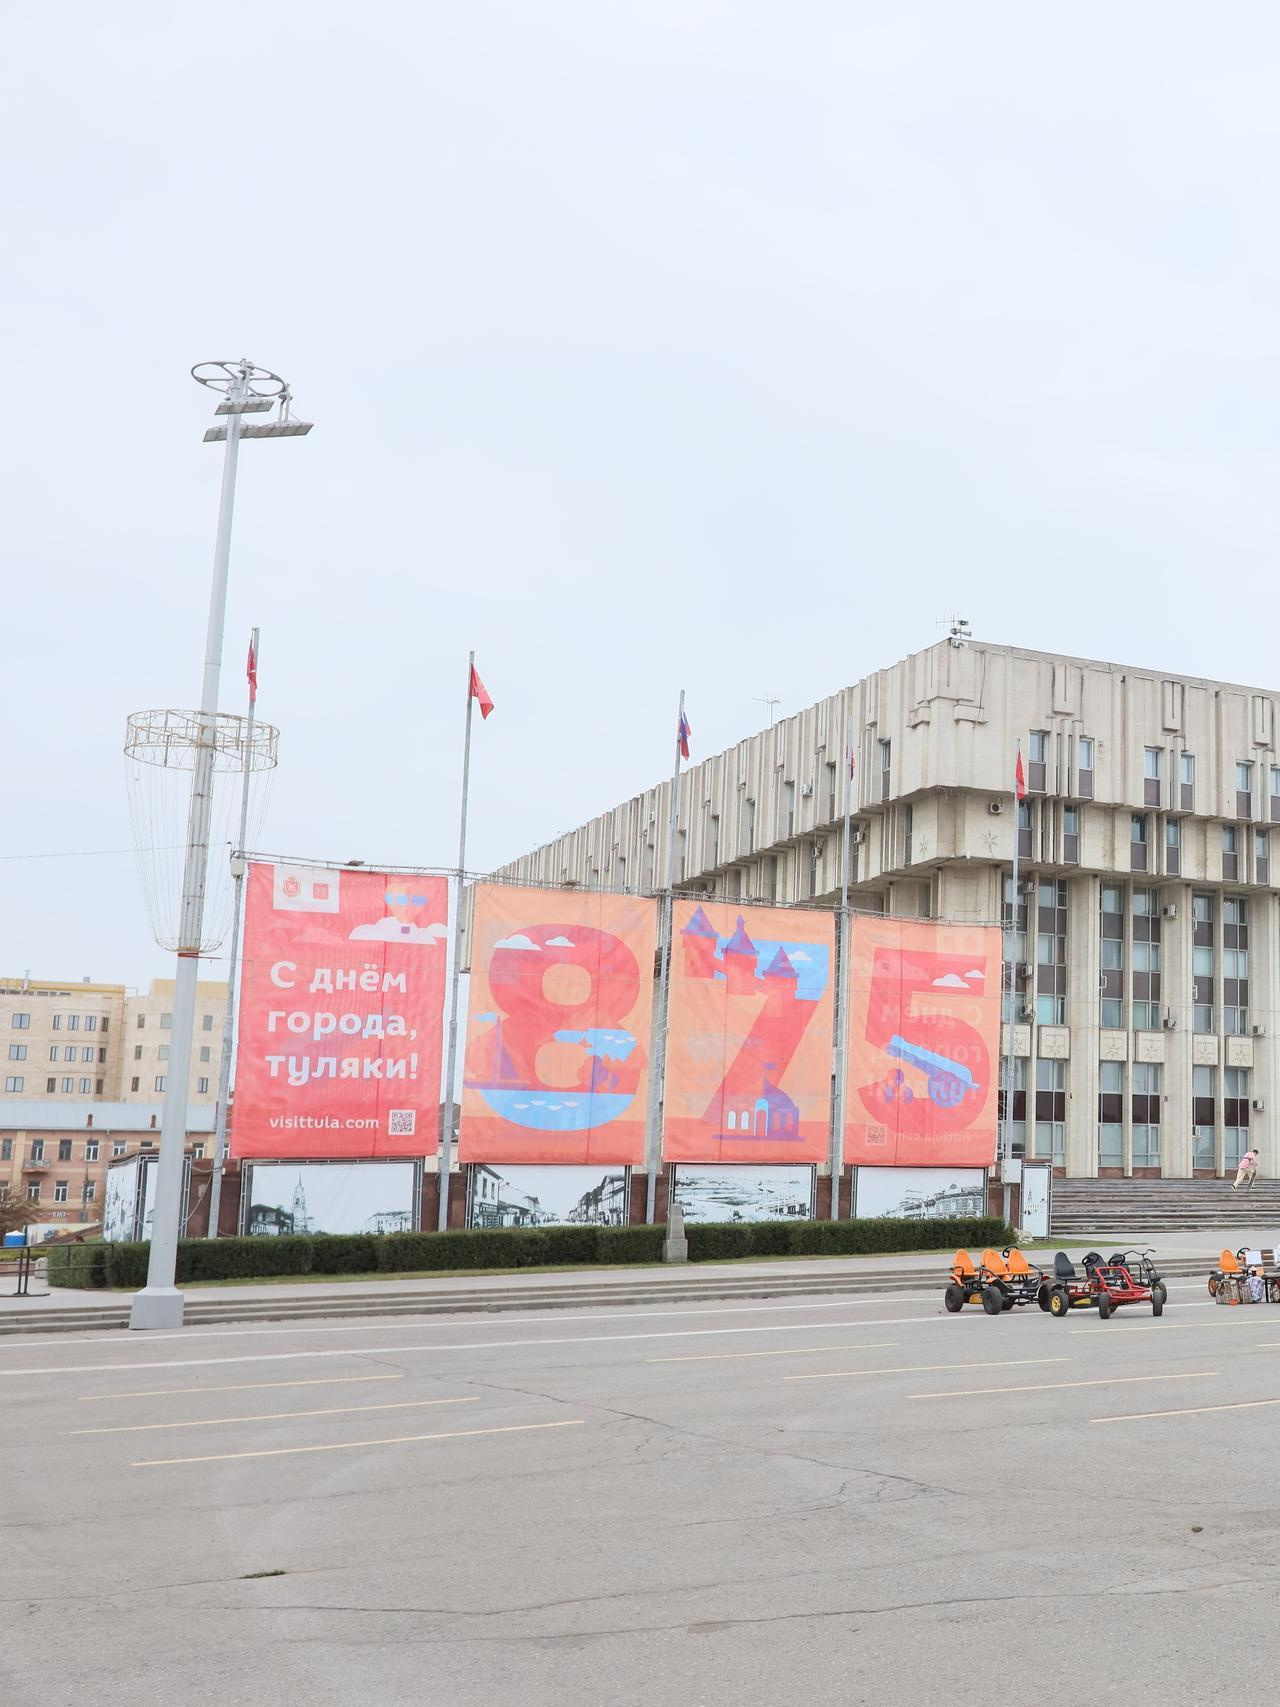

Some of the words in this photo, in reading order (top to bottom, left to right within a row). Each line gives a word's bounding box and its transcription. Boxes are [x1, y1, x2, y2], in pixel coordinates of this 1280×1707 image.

[270, 960, 297, 989] С
[309, 963, 408, 994] днём
[267, 1010, 418, 1041] города,
[465, 923, 648, 1131] 8
[857, 947, 990, 1133] 5
[264, 1053, 419, 1087] туляки!
[269, 1115, 380, 1129] visittula.com
